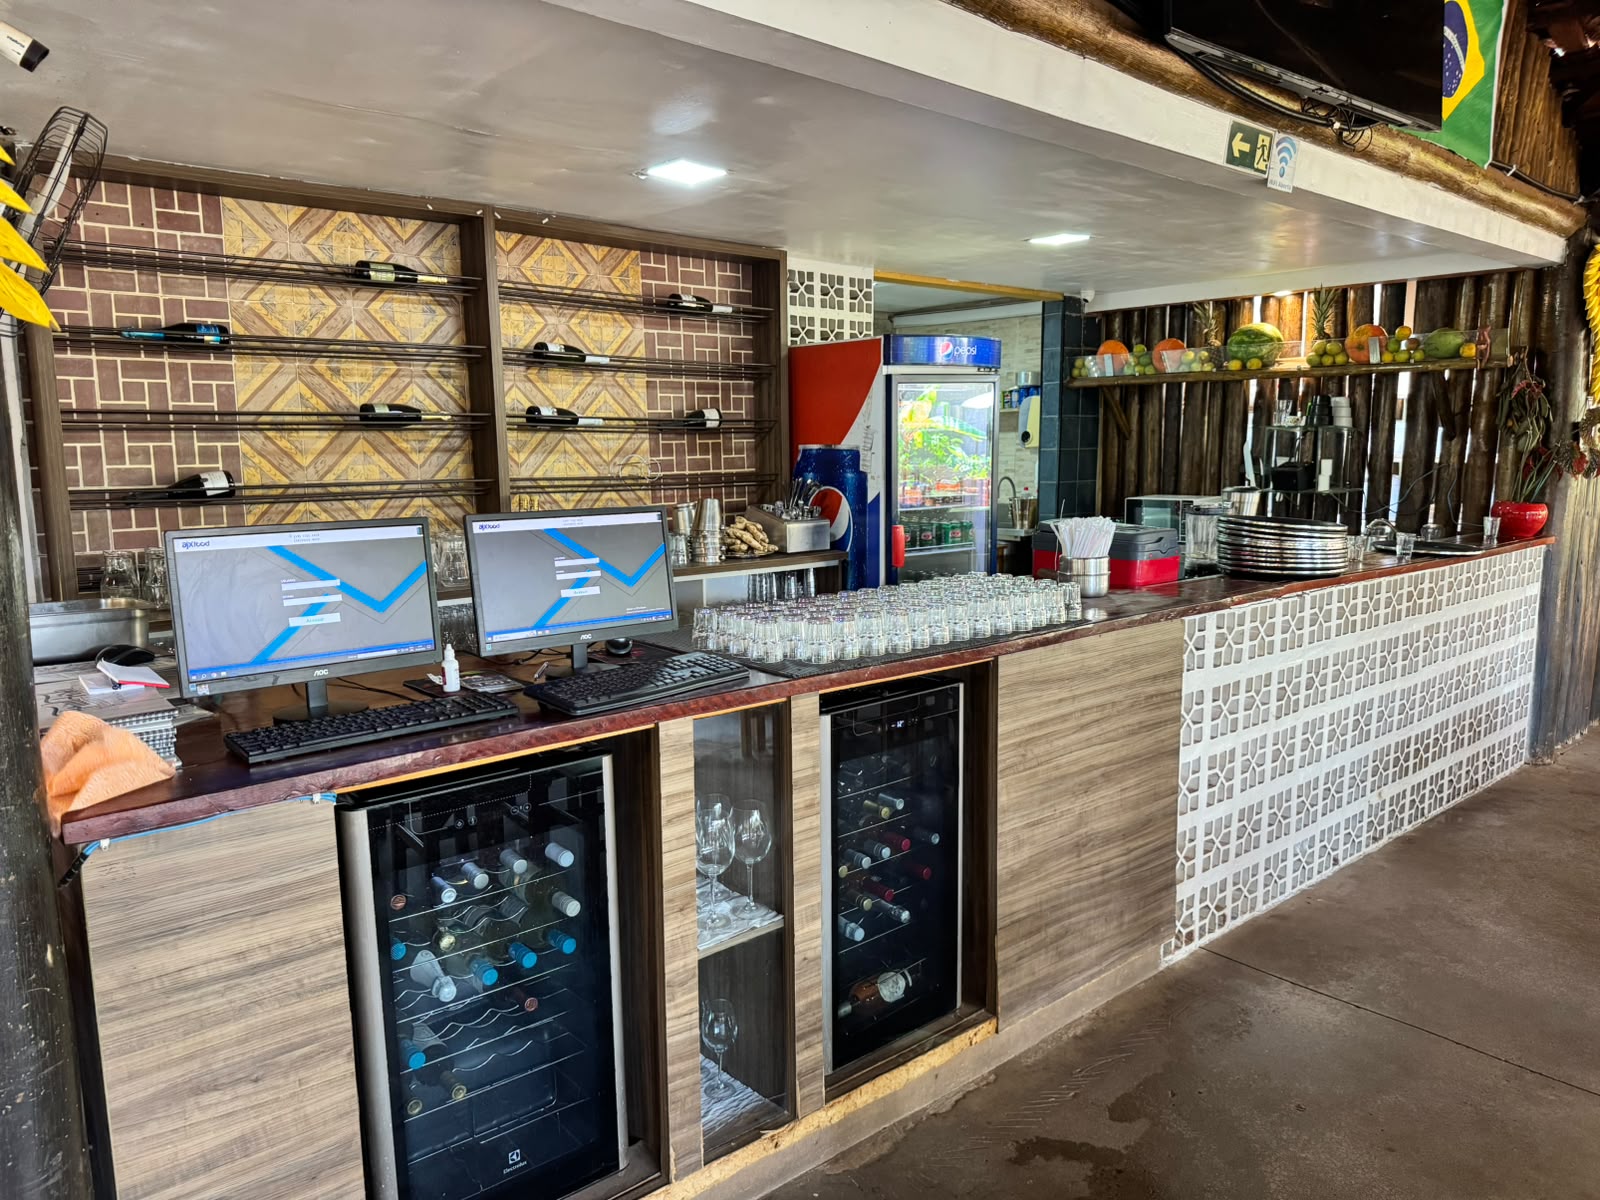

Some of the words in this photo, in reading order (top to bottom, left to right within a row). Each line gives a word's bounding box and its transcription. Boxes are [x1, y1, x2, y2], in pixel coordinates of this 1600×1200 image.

[954, 345, 977, 357] pepsi
[580, 633, 593, 641] AOC
[313, 669, 329, 677] AOC
